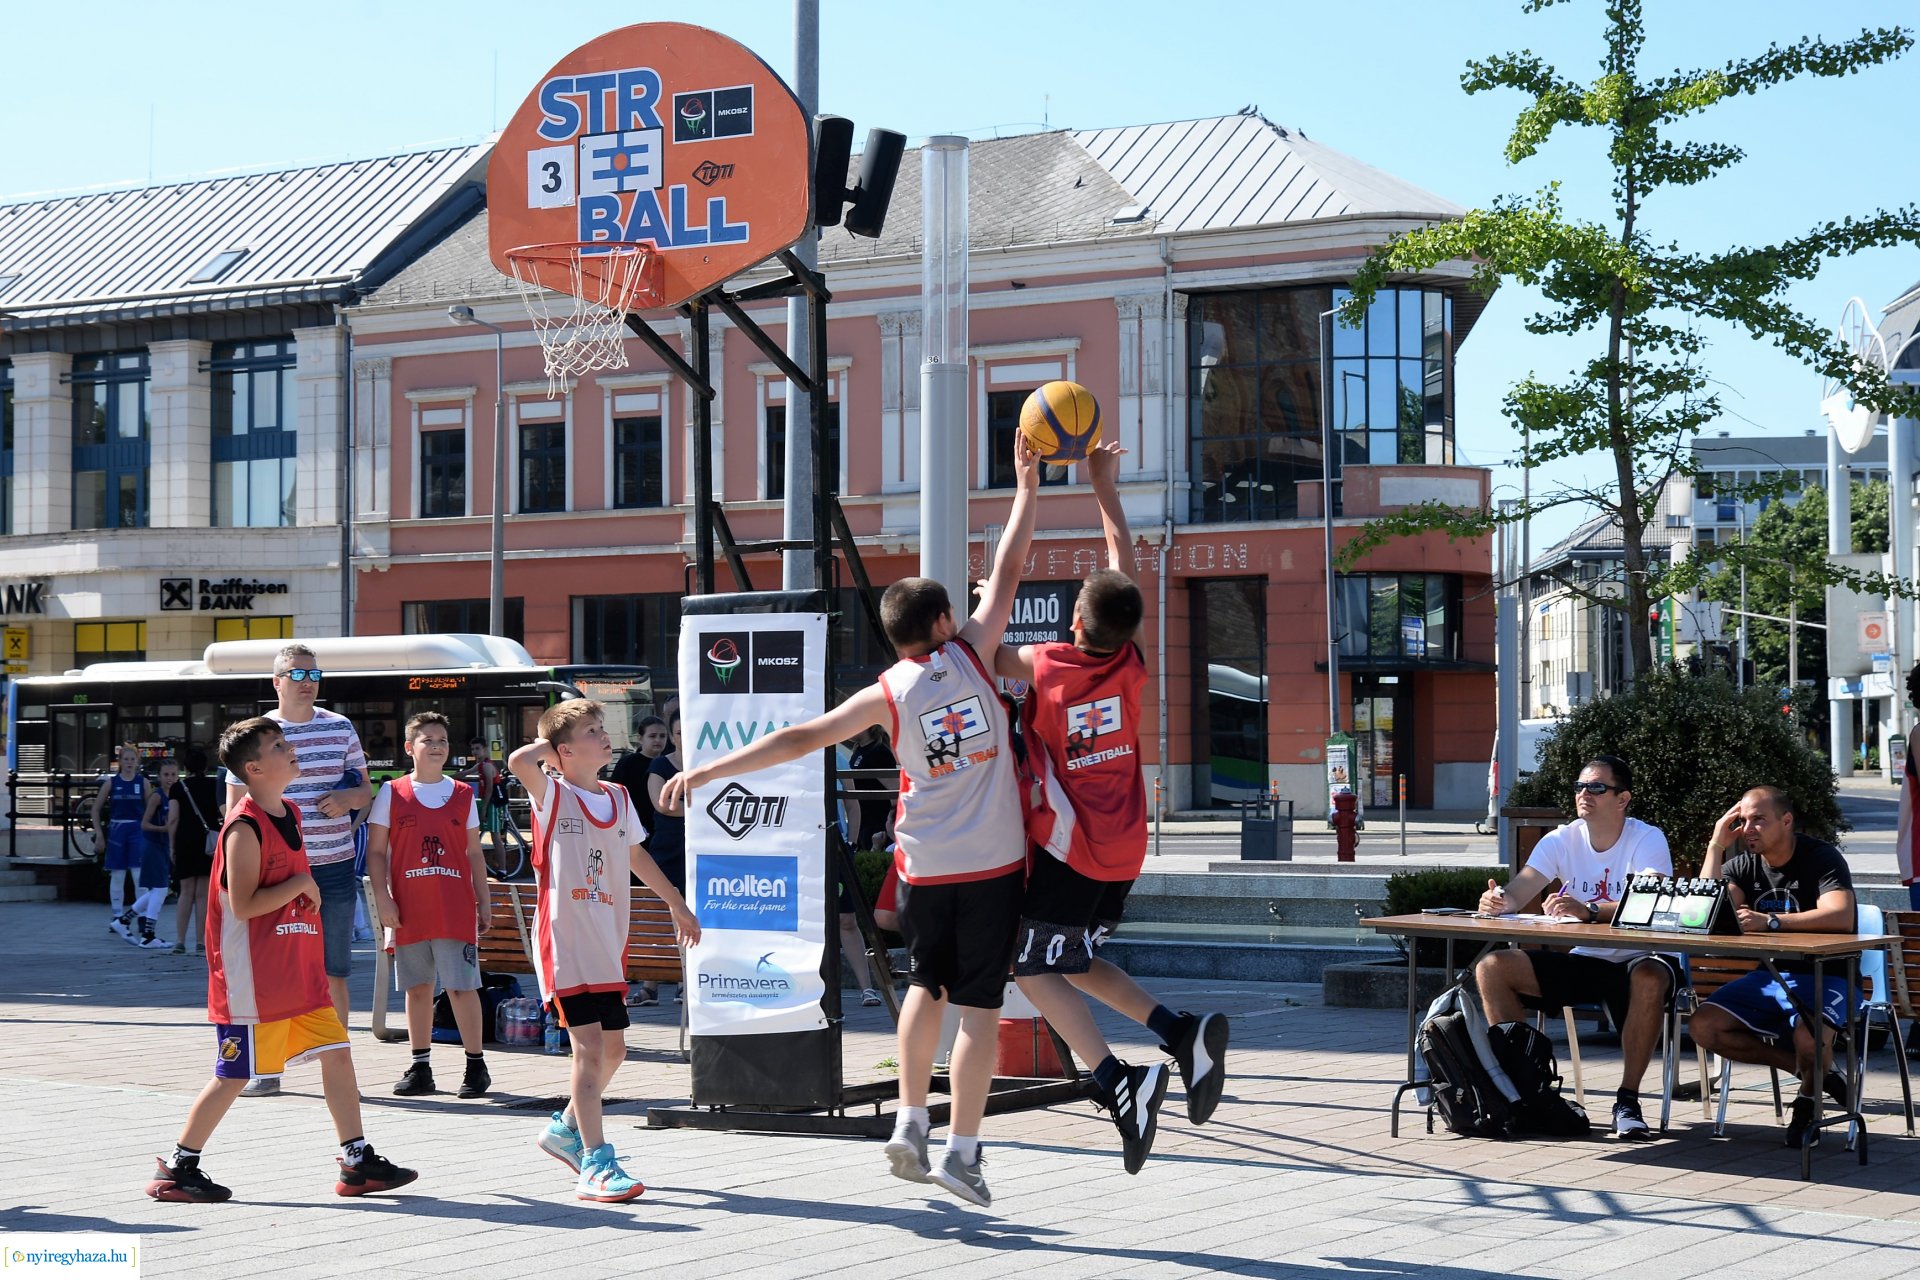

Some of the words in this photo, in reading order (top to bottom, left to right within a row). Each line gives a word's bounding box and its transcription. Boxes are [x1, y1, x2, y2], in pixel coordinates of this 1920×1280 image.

[536, 67, 664, 141] STR
[717, 107, 748, 117] MKOSZ
[541, 161, 562, 193] 3
[702, 164, 735, 181] TOTI
[578, 184, 749, 256] BALL
[1048, 543, 1248, 576] FAHION
[199, 578, 288, 594] Raiffeisen
[200, 595, 254, 610] BANK
[757, 657, 799, 666] MKOSZ
[409, 678, 420, 690] 20
[1066, 744, 1133, 770] STREETBALL
[723, 796, 788, 828] TOTI
[405, 866, 461, 878] STREETBALL
[708, 874, 786, 898] molten
[1572, 876, 1623, 896] JORDA
[704, 899, 721, 910] For
[721, 900, 738, 910] the
[738, 900, 759, 911] real
[759, 904, 787, 914] game
[698, 973, 791, 990] Primavera
